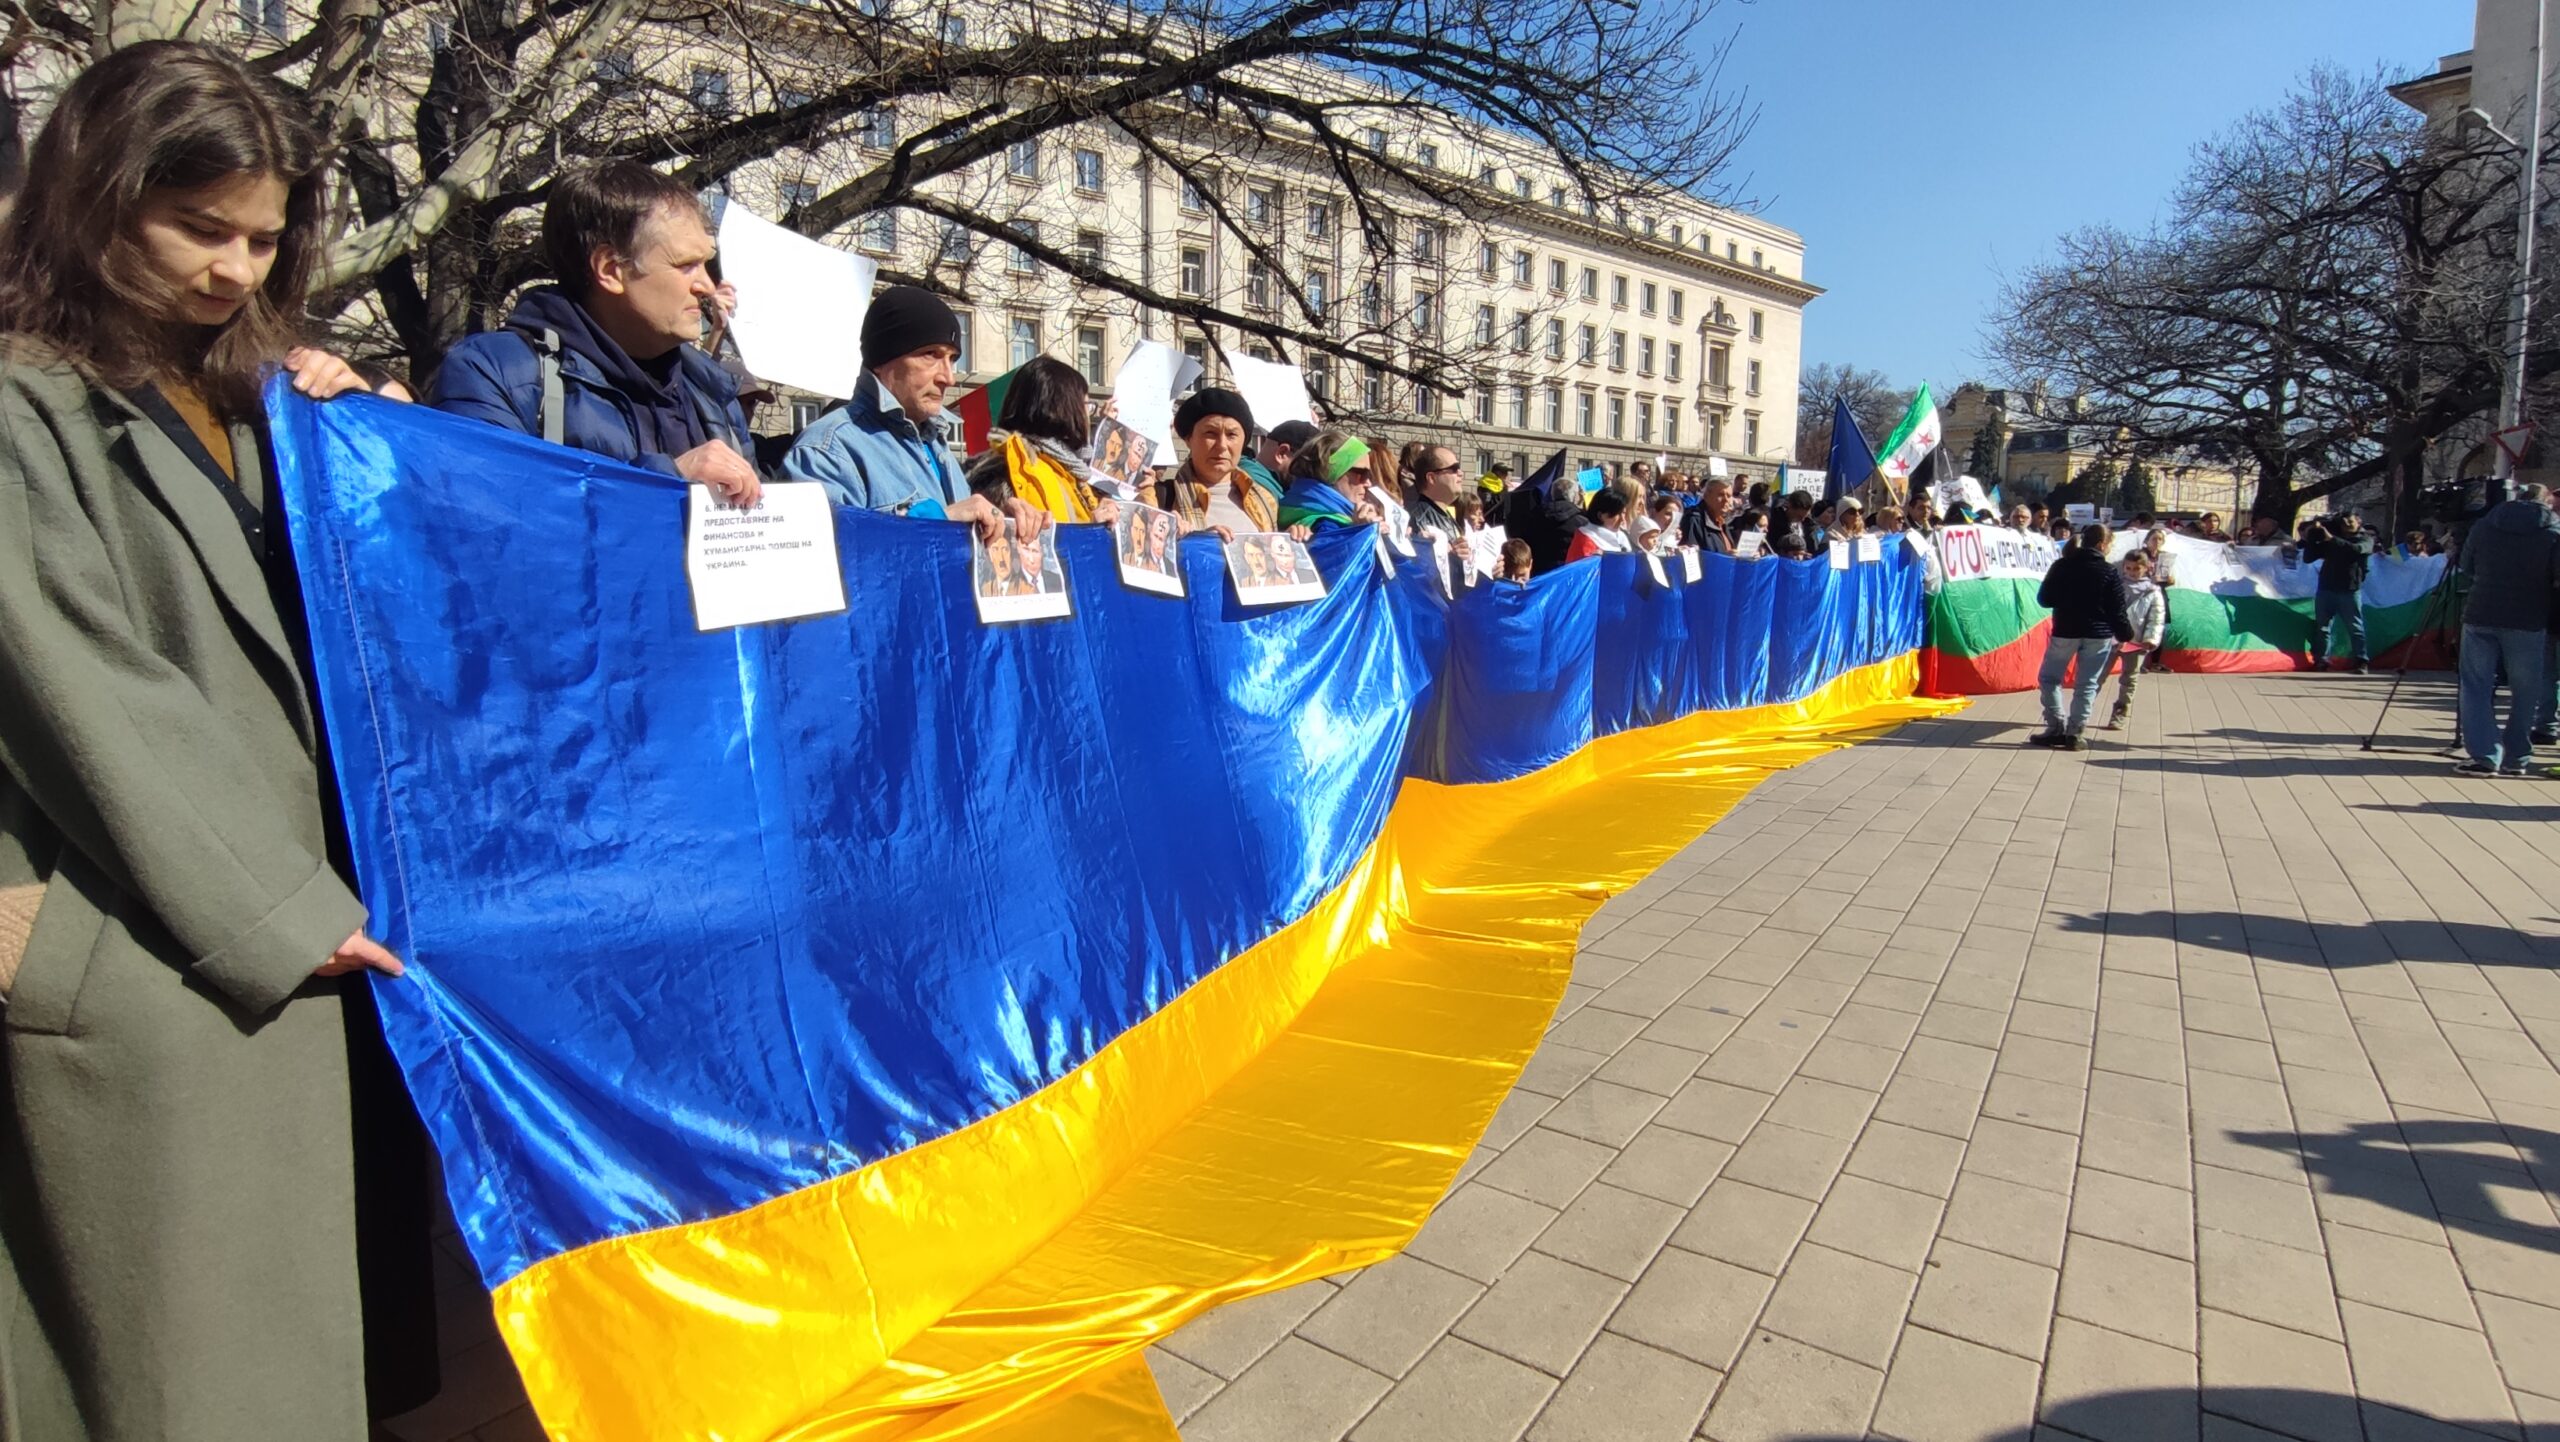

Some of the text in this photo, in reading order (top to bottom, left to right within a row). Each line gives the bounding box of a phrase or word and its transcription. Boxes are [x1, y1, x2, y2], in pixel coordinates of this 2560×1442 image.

[704, 515, 785, 527] ПРЕДОСТАВЯНЕ НА
[703, 530, 755, 541] ФИНАНСОВА
[703, 543, 766, 556] ХУМАНИТАРНА
[801, 540, 812, 548] НА
[705, 560, 748, 571] УКРАИНА.
